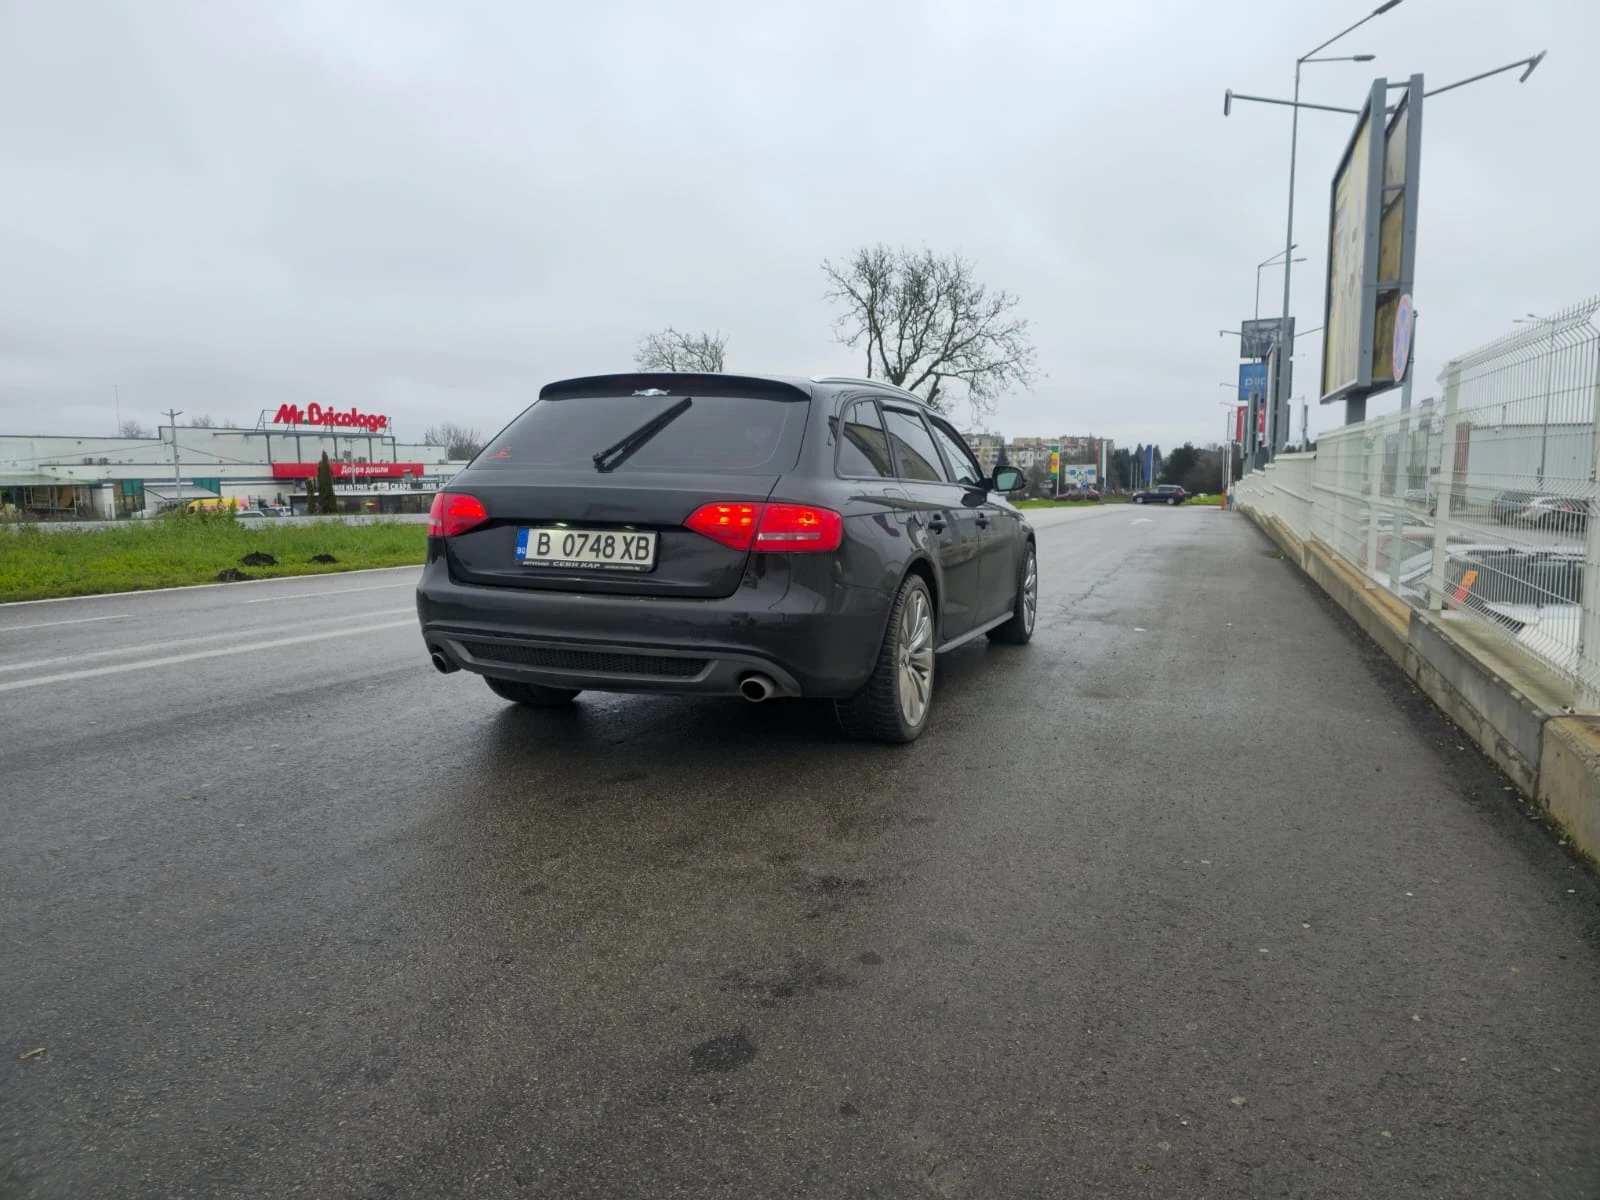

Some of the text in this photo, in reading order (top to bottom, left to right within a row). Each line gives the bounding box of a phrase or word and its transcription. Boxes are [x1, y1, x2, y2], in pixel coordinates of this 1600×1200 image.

[537, 532, 650, 561] B 0748 XB
